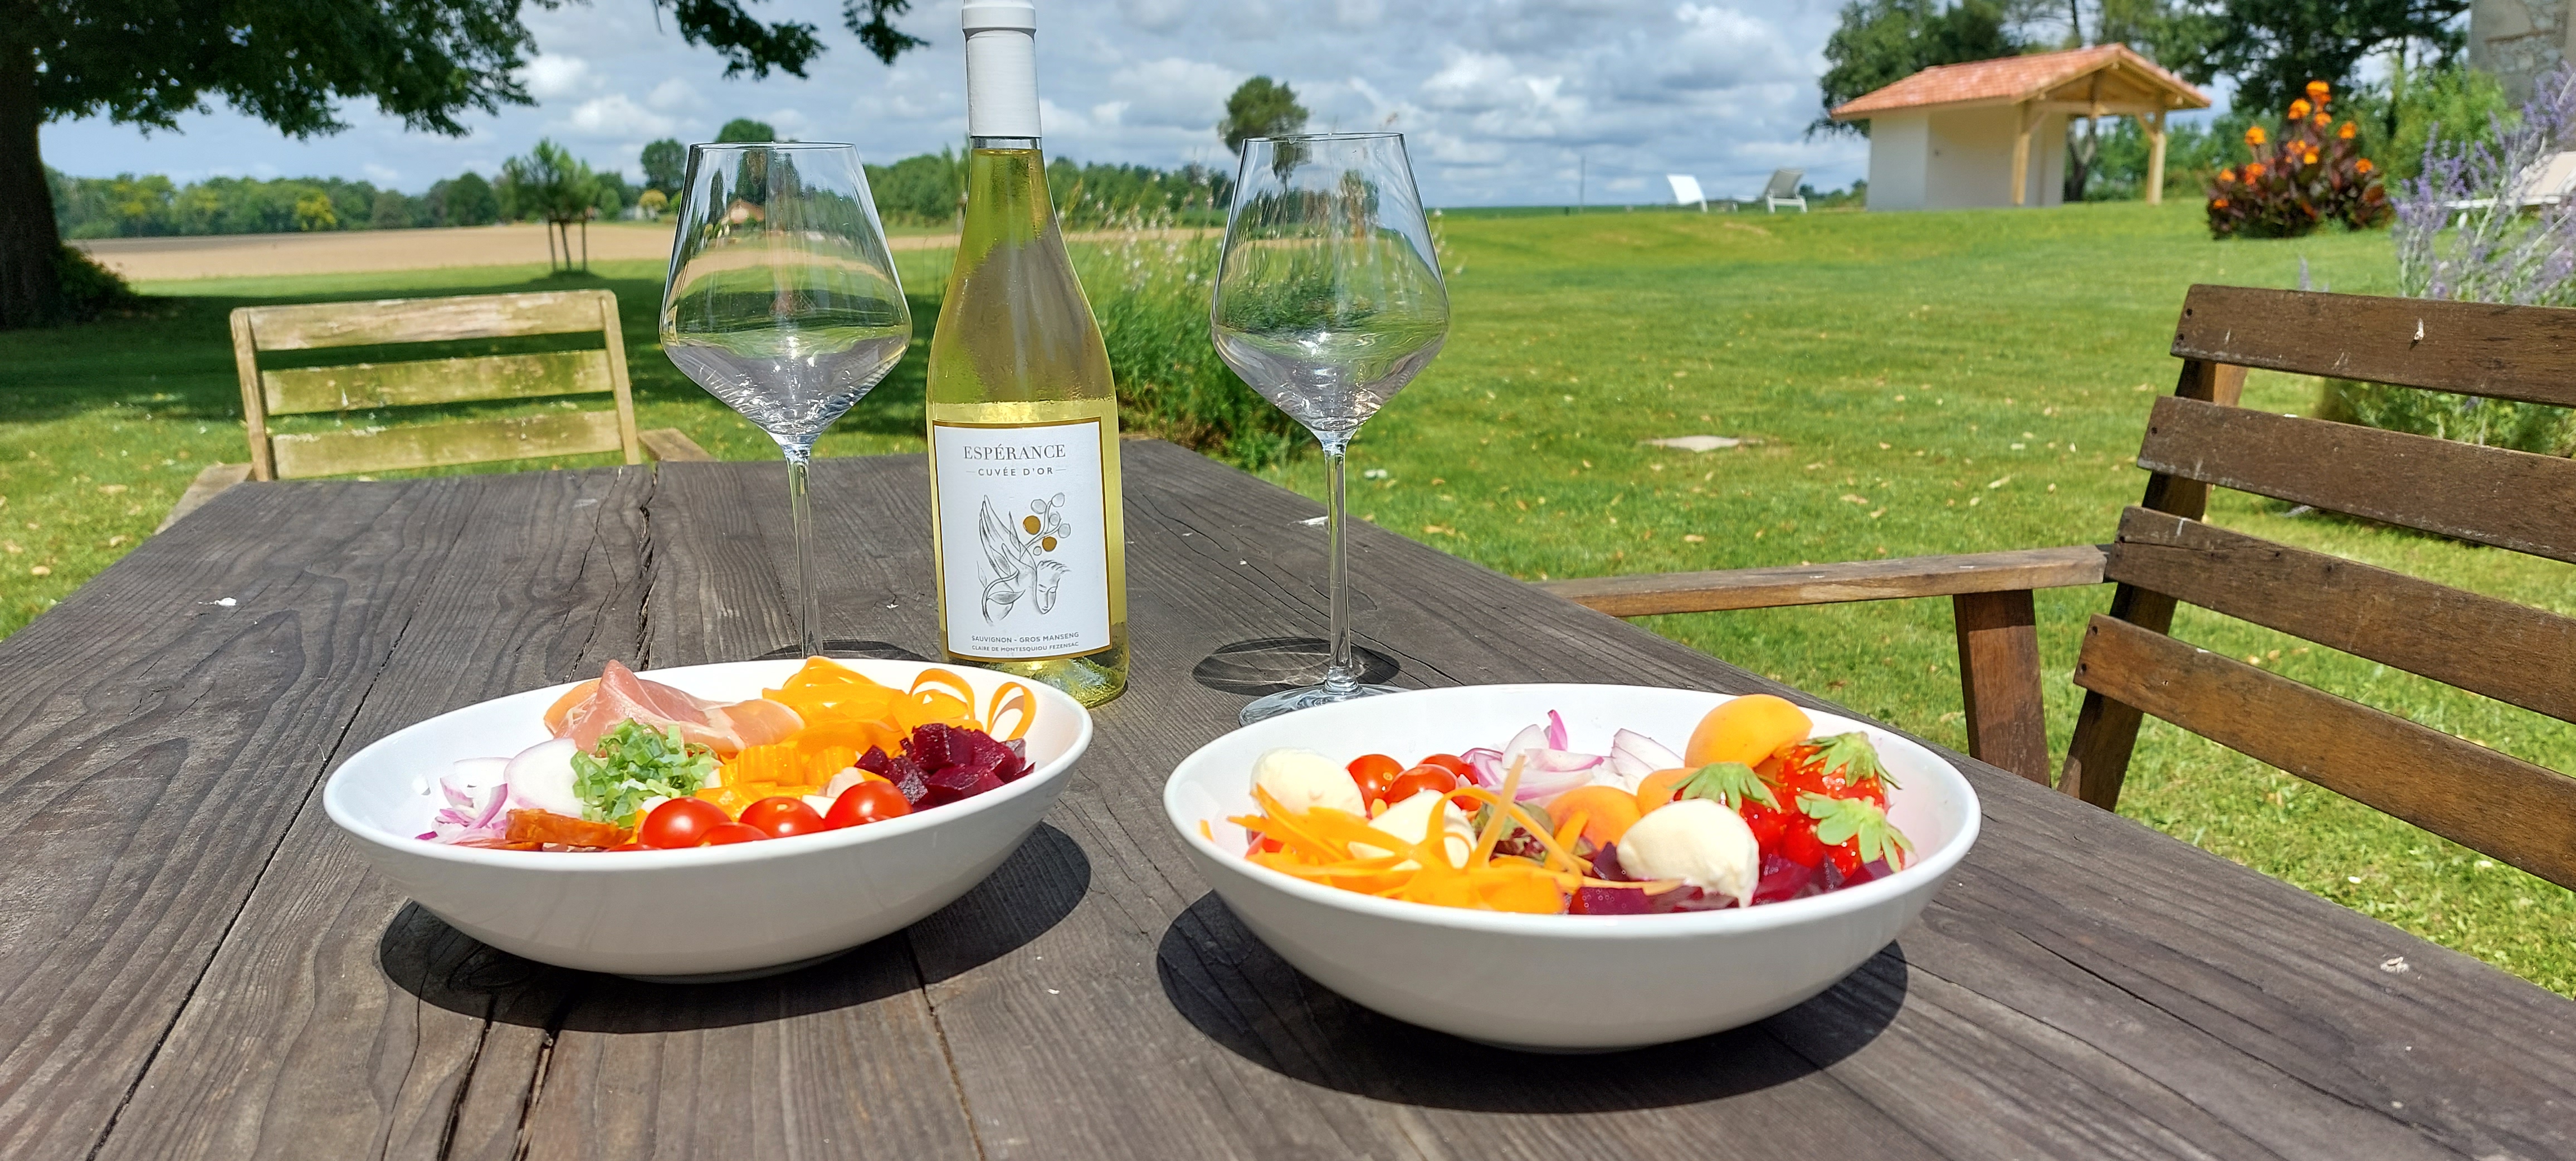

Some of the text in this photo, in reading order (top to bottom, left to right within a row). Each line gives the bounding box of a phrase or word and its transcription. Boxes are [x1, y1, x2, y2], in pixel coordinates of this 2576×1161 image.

[963, 443, 1066, 460] ESPÉRANCE
[978, 467, 1053, 476] CUVÉE D'OR
[1043, 632, 1079, 641] MANSENG
